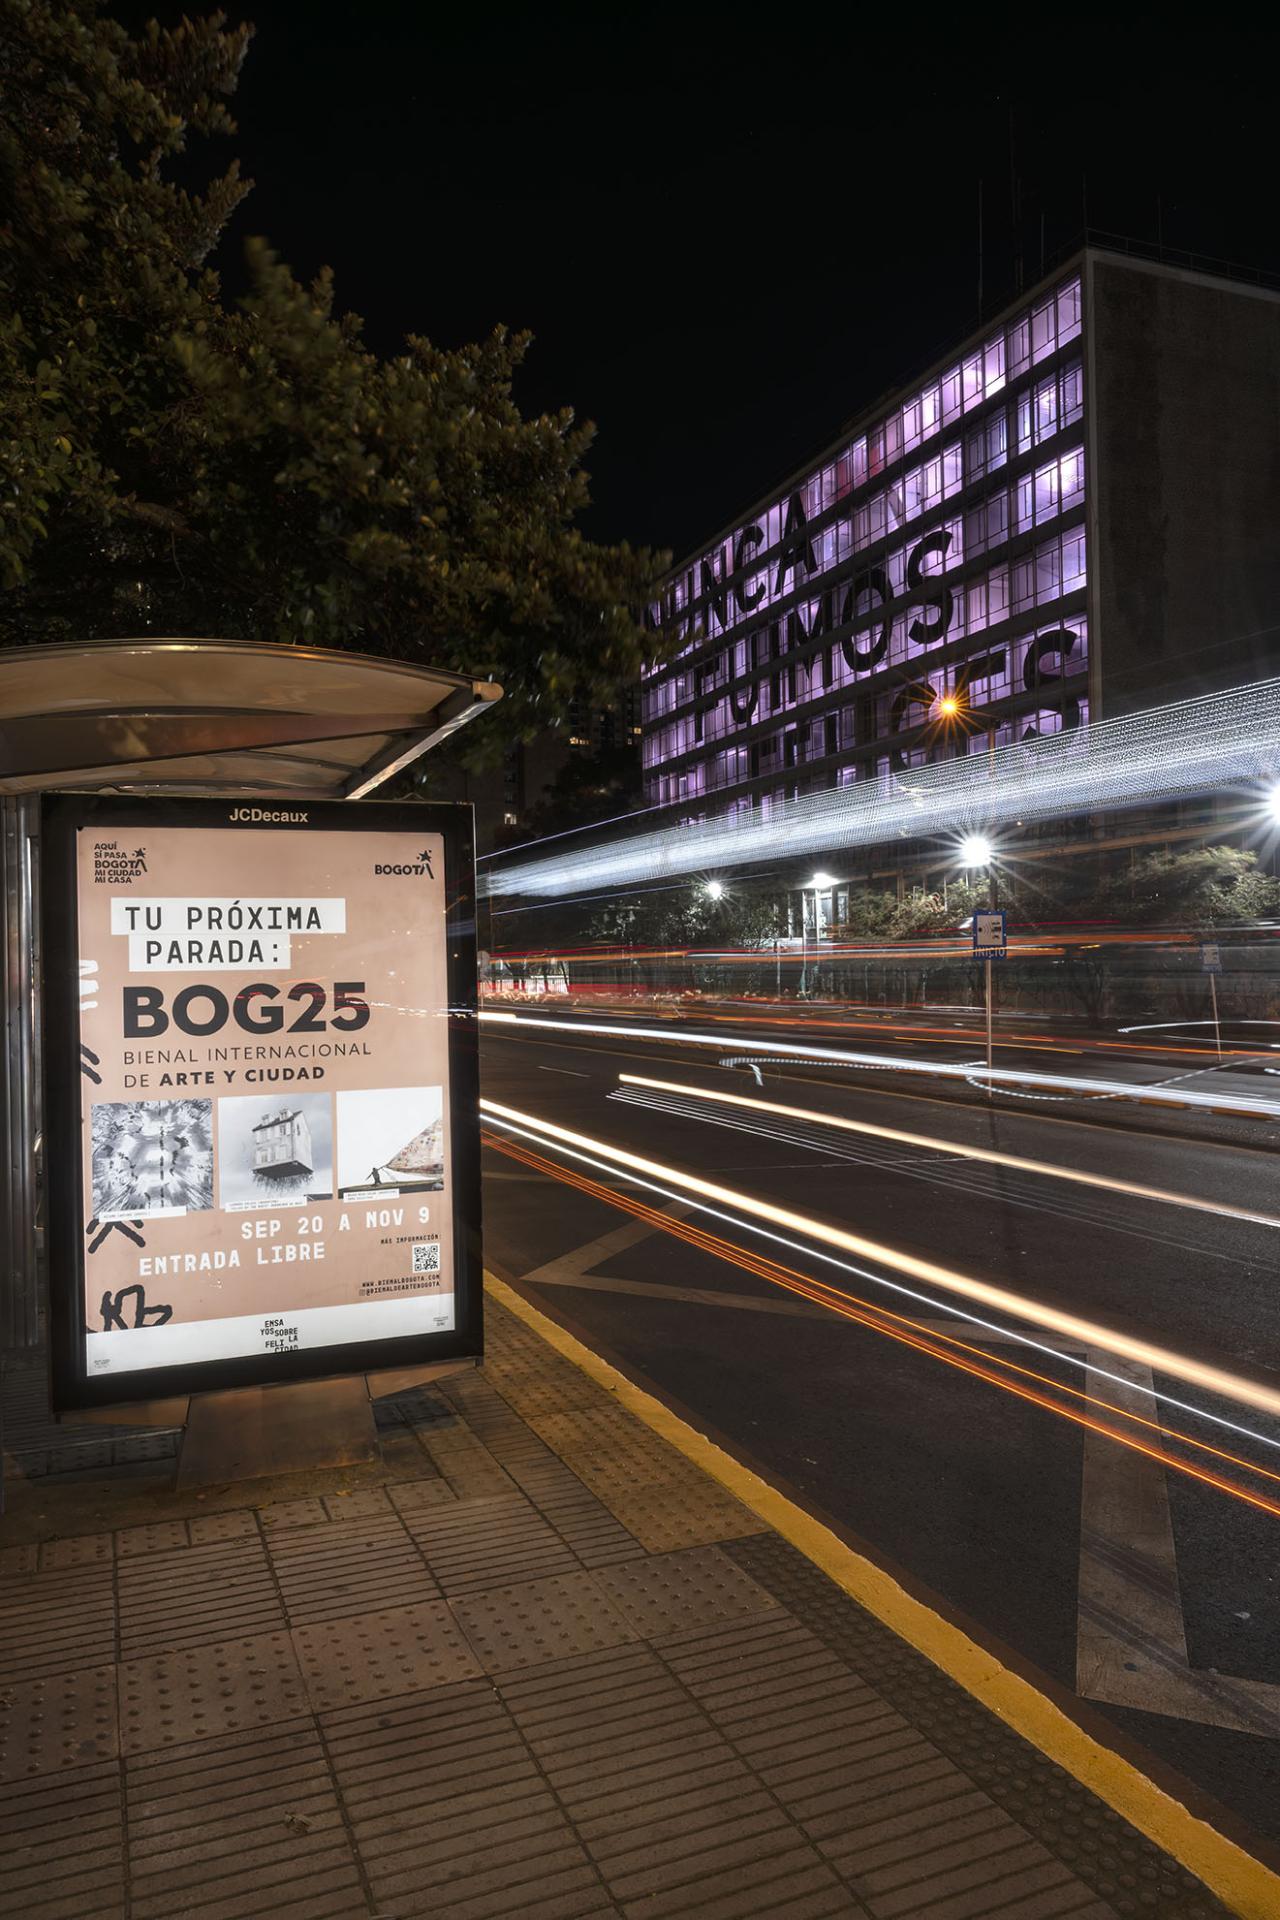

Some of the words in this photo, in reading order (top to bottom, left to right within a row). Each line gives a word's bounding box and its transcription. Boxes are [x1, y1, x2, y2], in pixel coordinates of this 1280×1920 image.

[229, 808, 309, 823] JCDecaux
[94, 841, 117, 850] AQUÍ
[107, 869, 142, 877] CIUDAD
[125, 906, 162, 930] TU
[187, 900, 322, 930] PRÓXIMA
[146, 940, 280, 964] PARADA:
[122, 982, 371, 1038] BOG25
[123, 1049, 198, 1065] BIENAL
[208, 1041, 371, 1061] INTERNACIONAL
[124, 1074, 149, 1088] DE
[159, 1070, 215, 1087] ARTE
[223, 1070, 237, 1083] Y
[245, 1066, 325, 1082] CIUDAD
[241, 1220, 281, 1240] SEP
[297, 1216, 324, 1235] 20
[338, 1213, 351, 1231] A
[366, 1208, 404, 1229] NOV
[419, 1206, 431, 1224] 9
[138, 1250, 240, 1276] ENTRADA
[257, 1242, 326, 1265] LIBRE
[260, 1328, 274, 1336] YOS
[274, 1327, 298, 1337] SOBRE
[264, 1318, 284, 1328] ENSA
[264, 1339, 284, 1348] FELI
